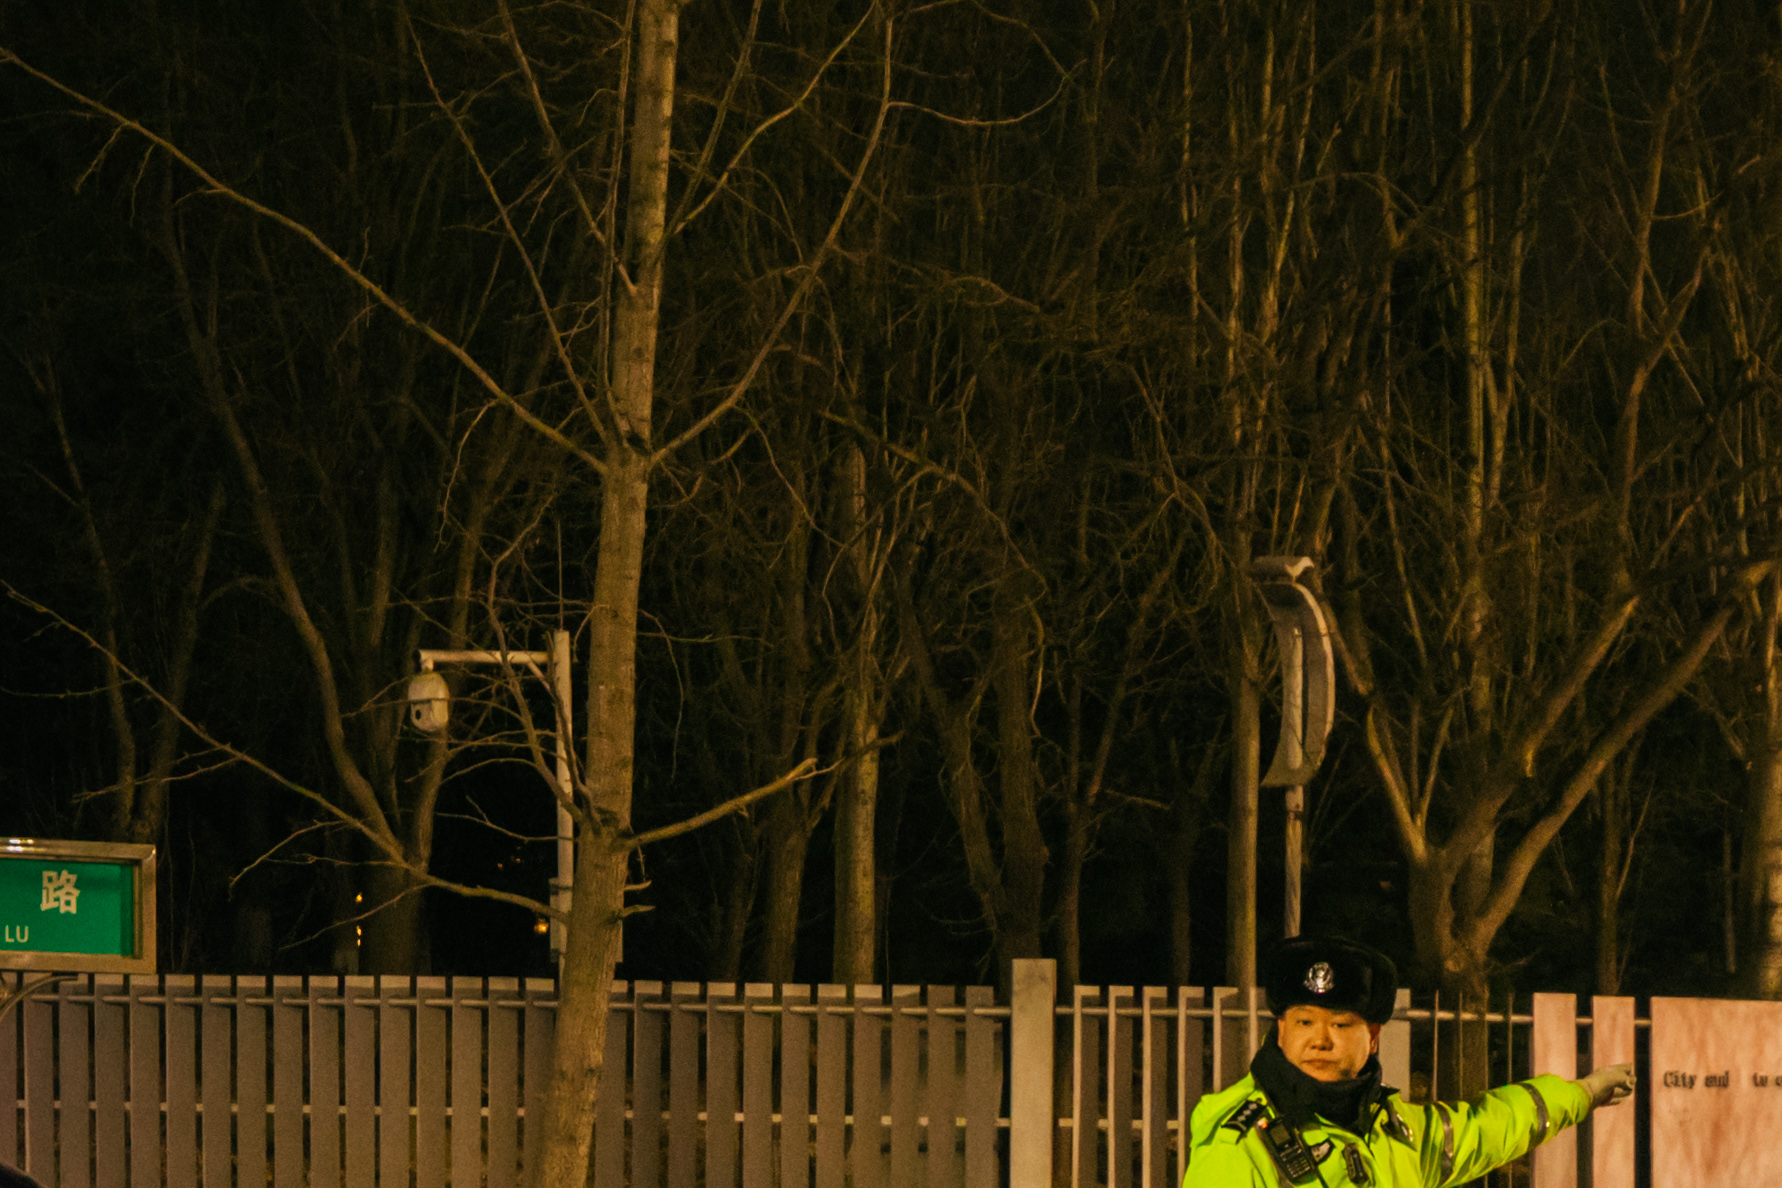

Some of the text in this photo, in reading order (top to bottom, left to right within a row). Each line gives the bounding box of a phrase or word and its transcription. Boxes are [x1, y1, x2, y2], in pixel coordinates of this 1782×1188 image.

[40, 869, 81, 915] 路
[4, 924, 30, 944] LU
[1663, 1070, 1697, 1089] City
